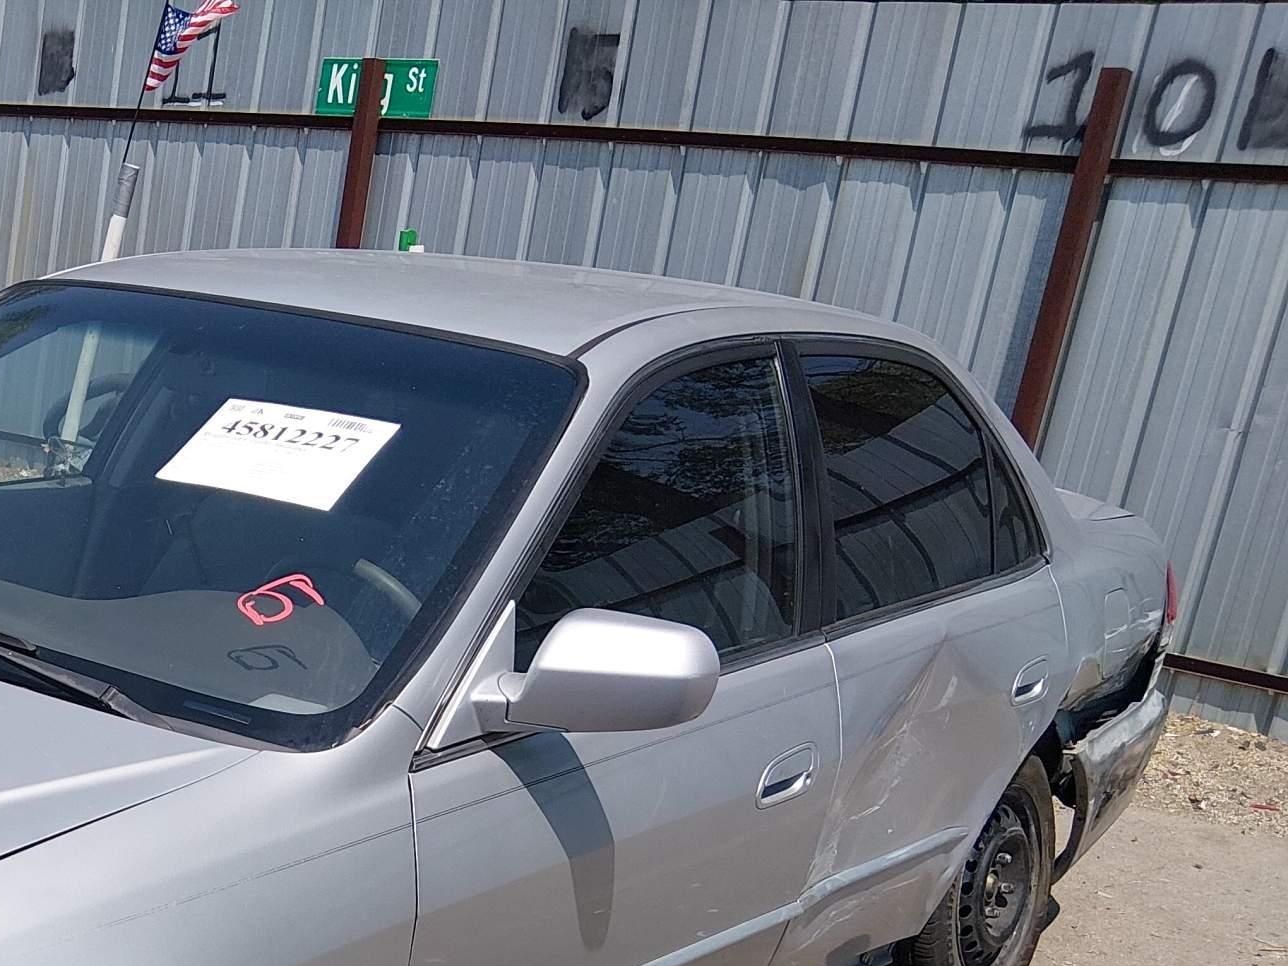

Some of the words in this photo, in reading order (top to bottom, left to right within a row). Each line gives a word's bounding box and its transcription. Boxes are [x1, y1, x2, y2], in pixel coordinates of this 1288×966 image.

[326, 62, 394, 116] Kig
[406, 66, 427, 93] St
[1021, 50, 1217, 147] 10
[221, 419, 360, 453] 45812227
